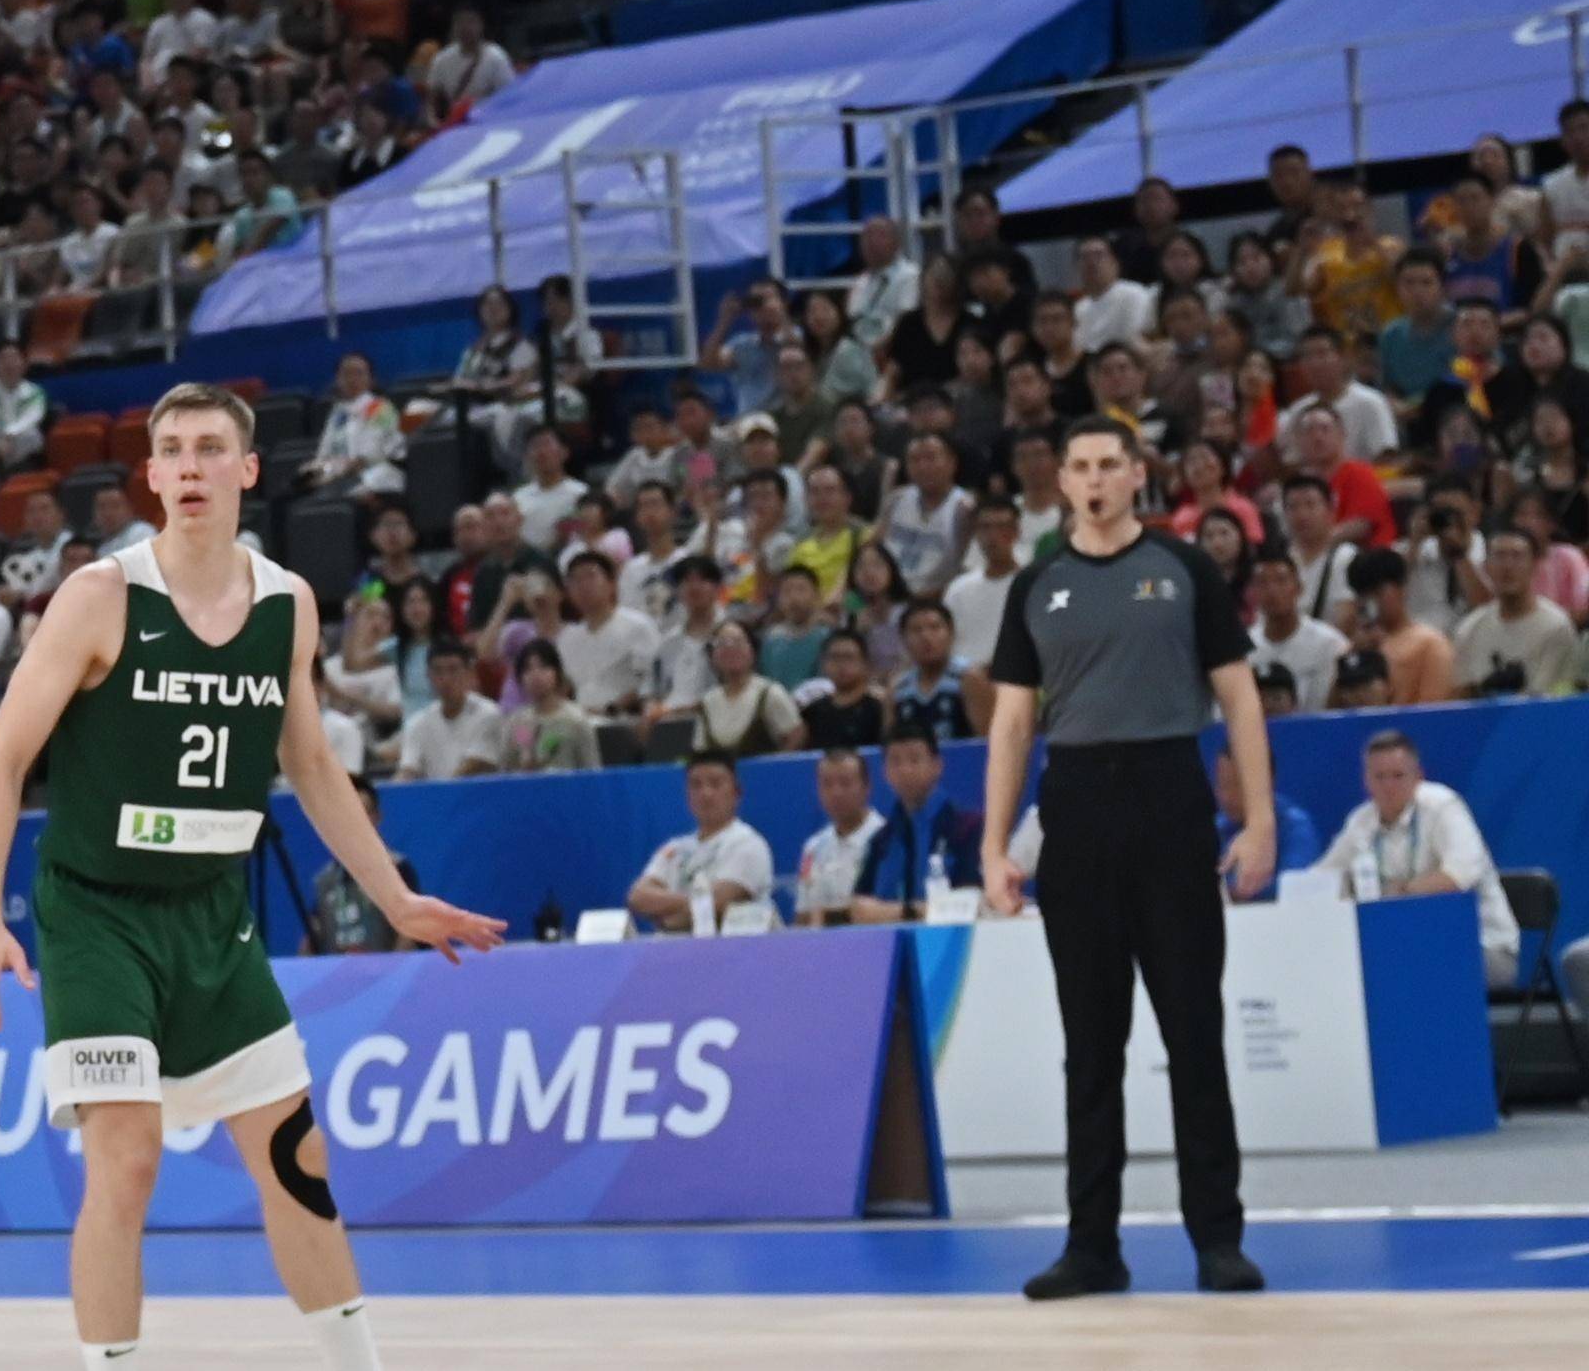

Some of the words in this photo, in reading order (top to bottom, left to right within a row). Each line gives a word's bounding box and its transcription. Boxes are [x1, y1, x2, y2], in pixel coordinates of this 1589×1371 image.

[131, 668, 285, 707] LIETUVA
[177, 724, 230, 789] 21
[75, 1050, 137, 1065] OLIVER
[83, 1068, 128, 1084] FLEET
[325, 1017, 741, 1151] GAMES
